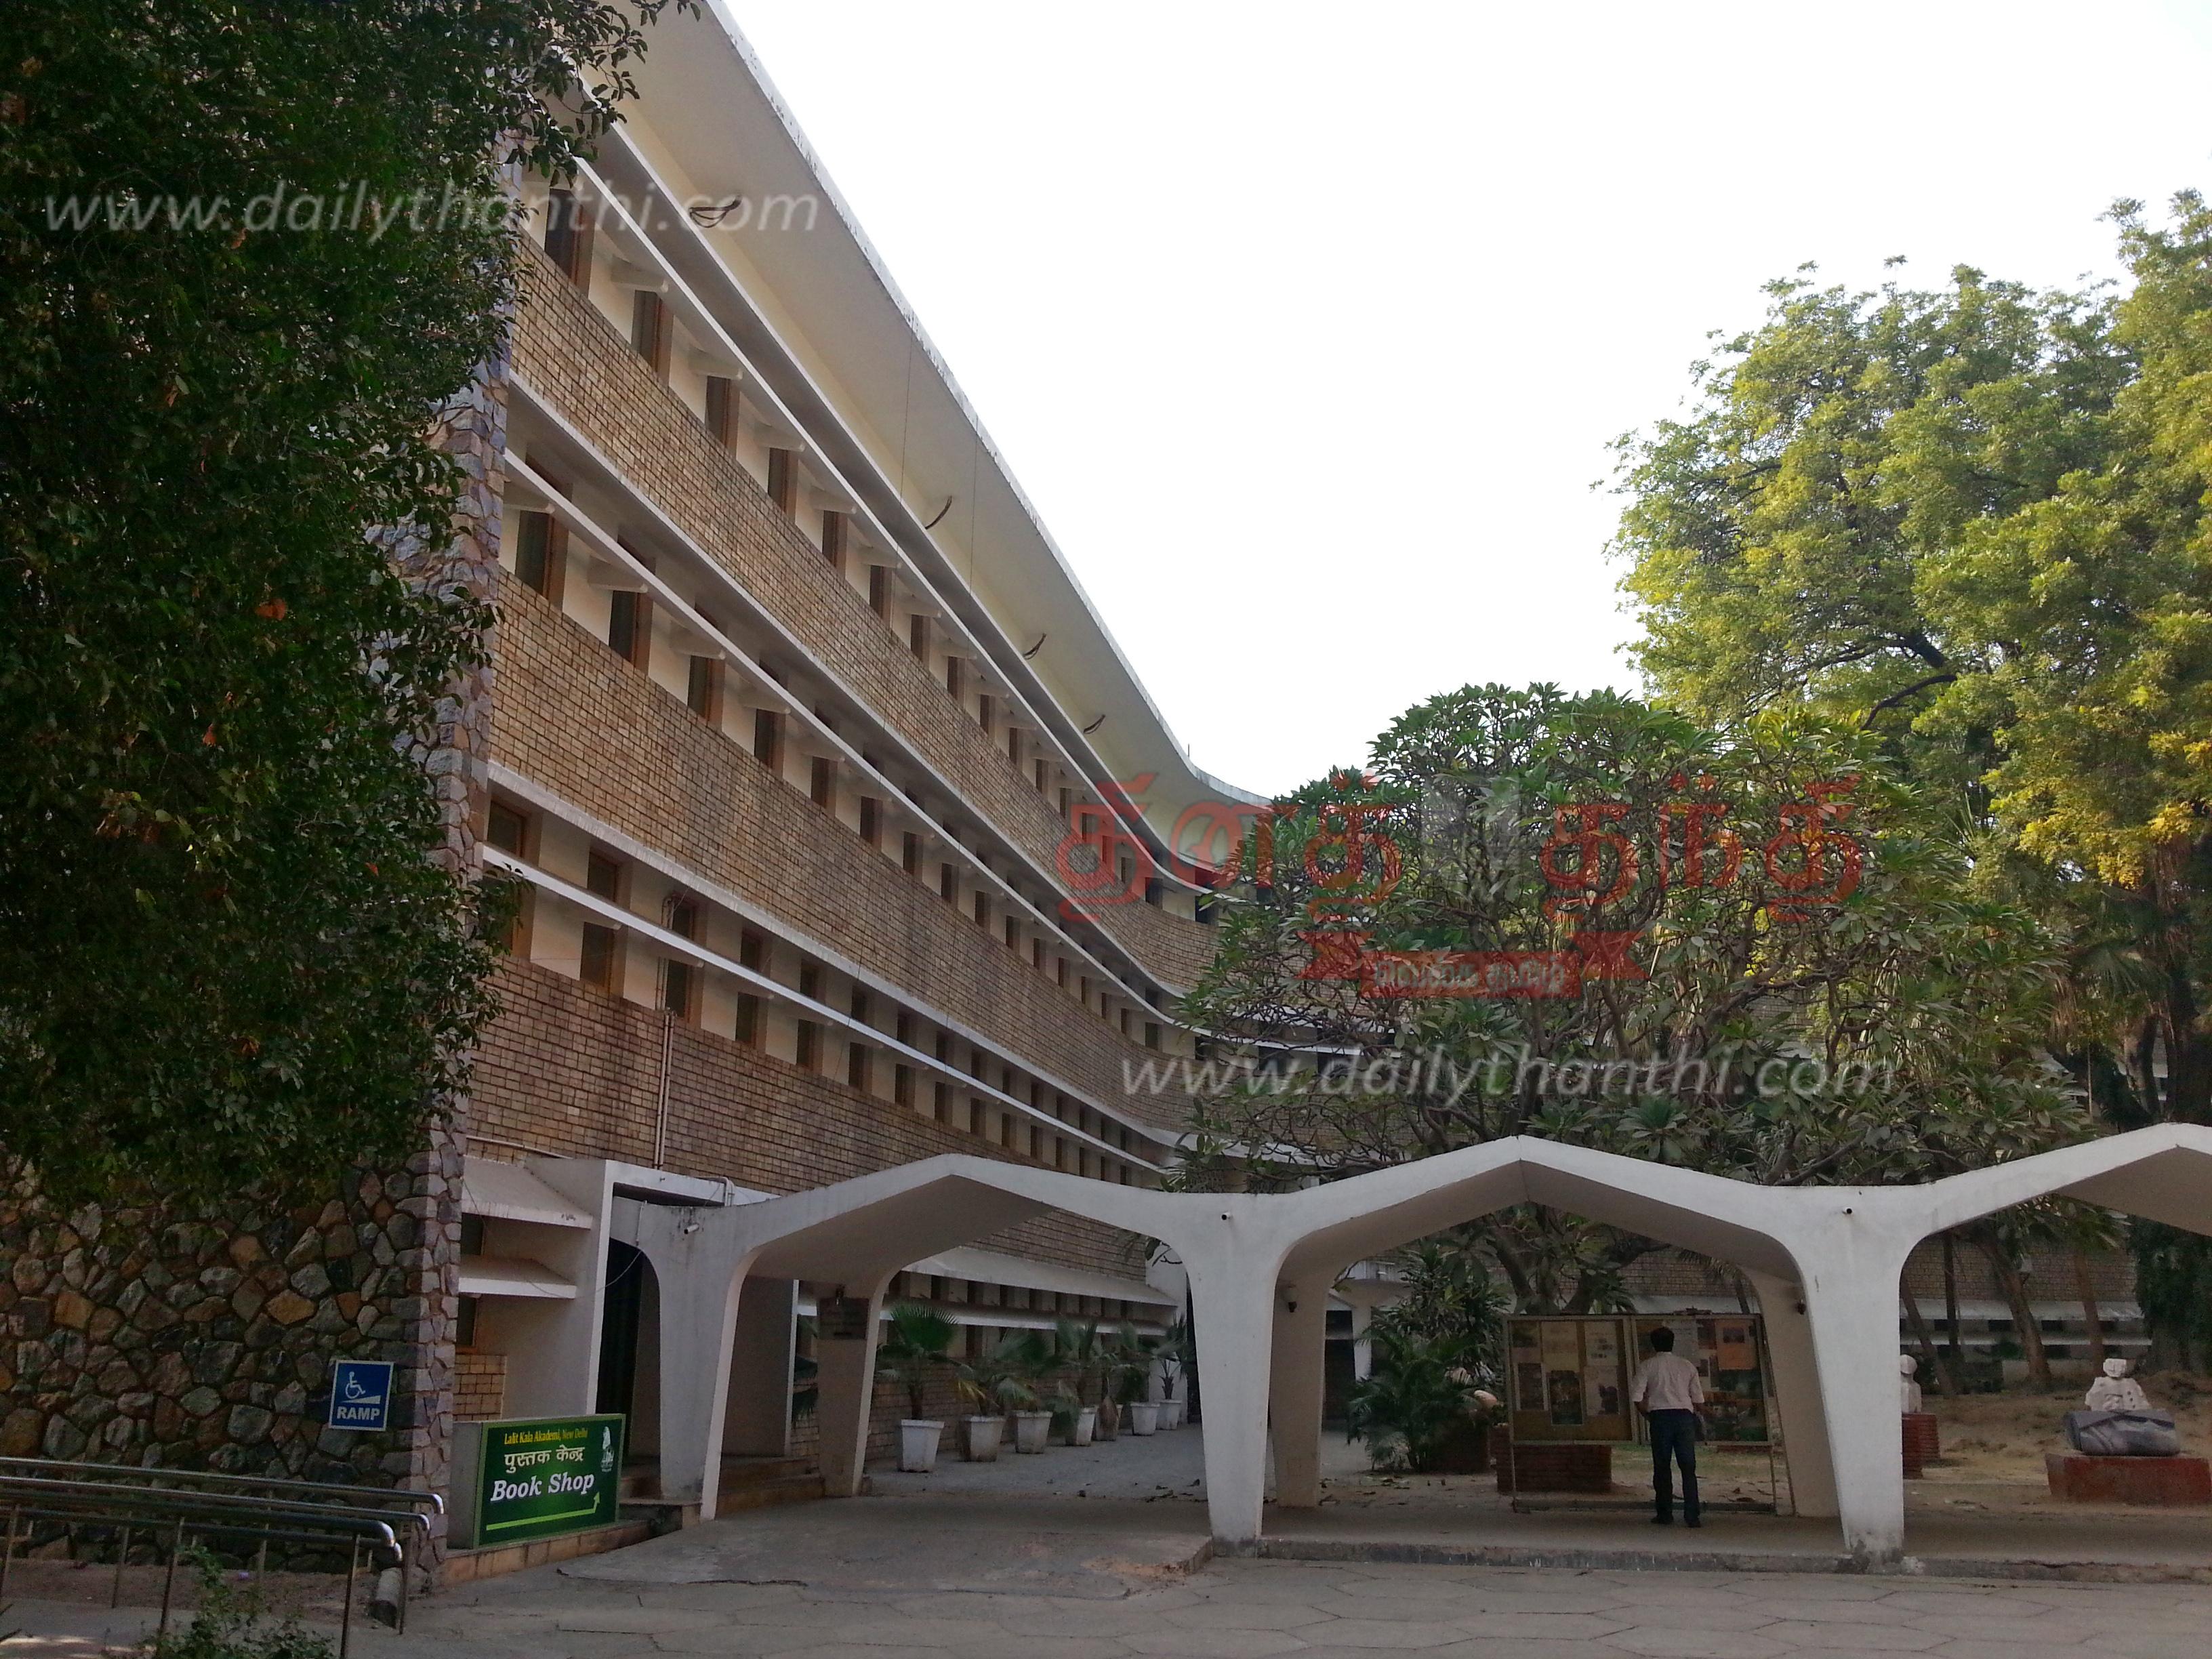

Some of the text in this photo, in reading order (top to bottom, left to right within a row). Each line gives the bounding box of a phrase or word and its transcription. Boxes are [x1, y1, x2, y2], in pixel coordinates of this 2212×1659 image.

[336, 1406, 381, 1420] RAMP
[504, 1427, 588, 1445] Lalit Kala Akademi, New Delhi
[504, 1443, 586, 1474] पुस्तक केन्द्र
[490, 1471, 594, 1502] Book Shop
